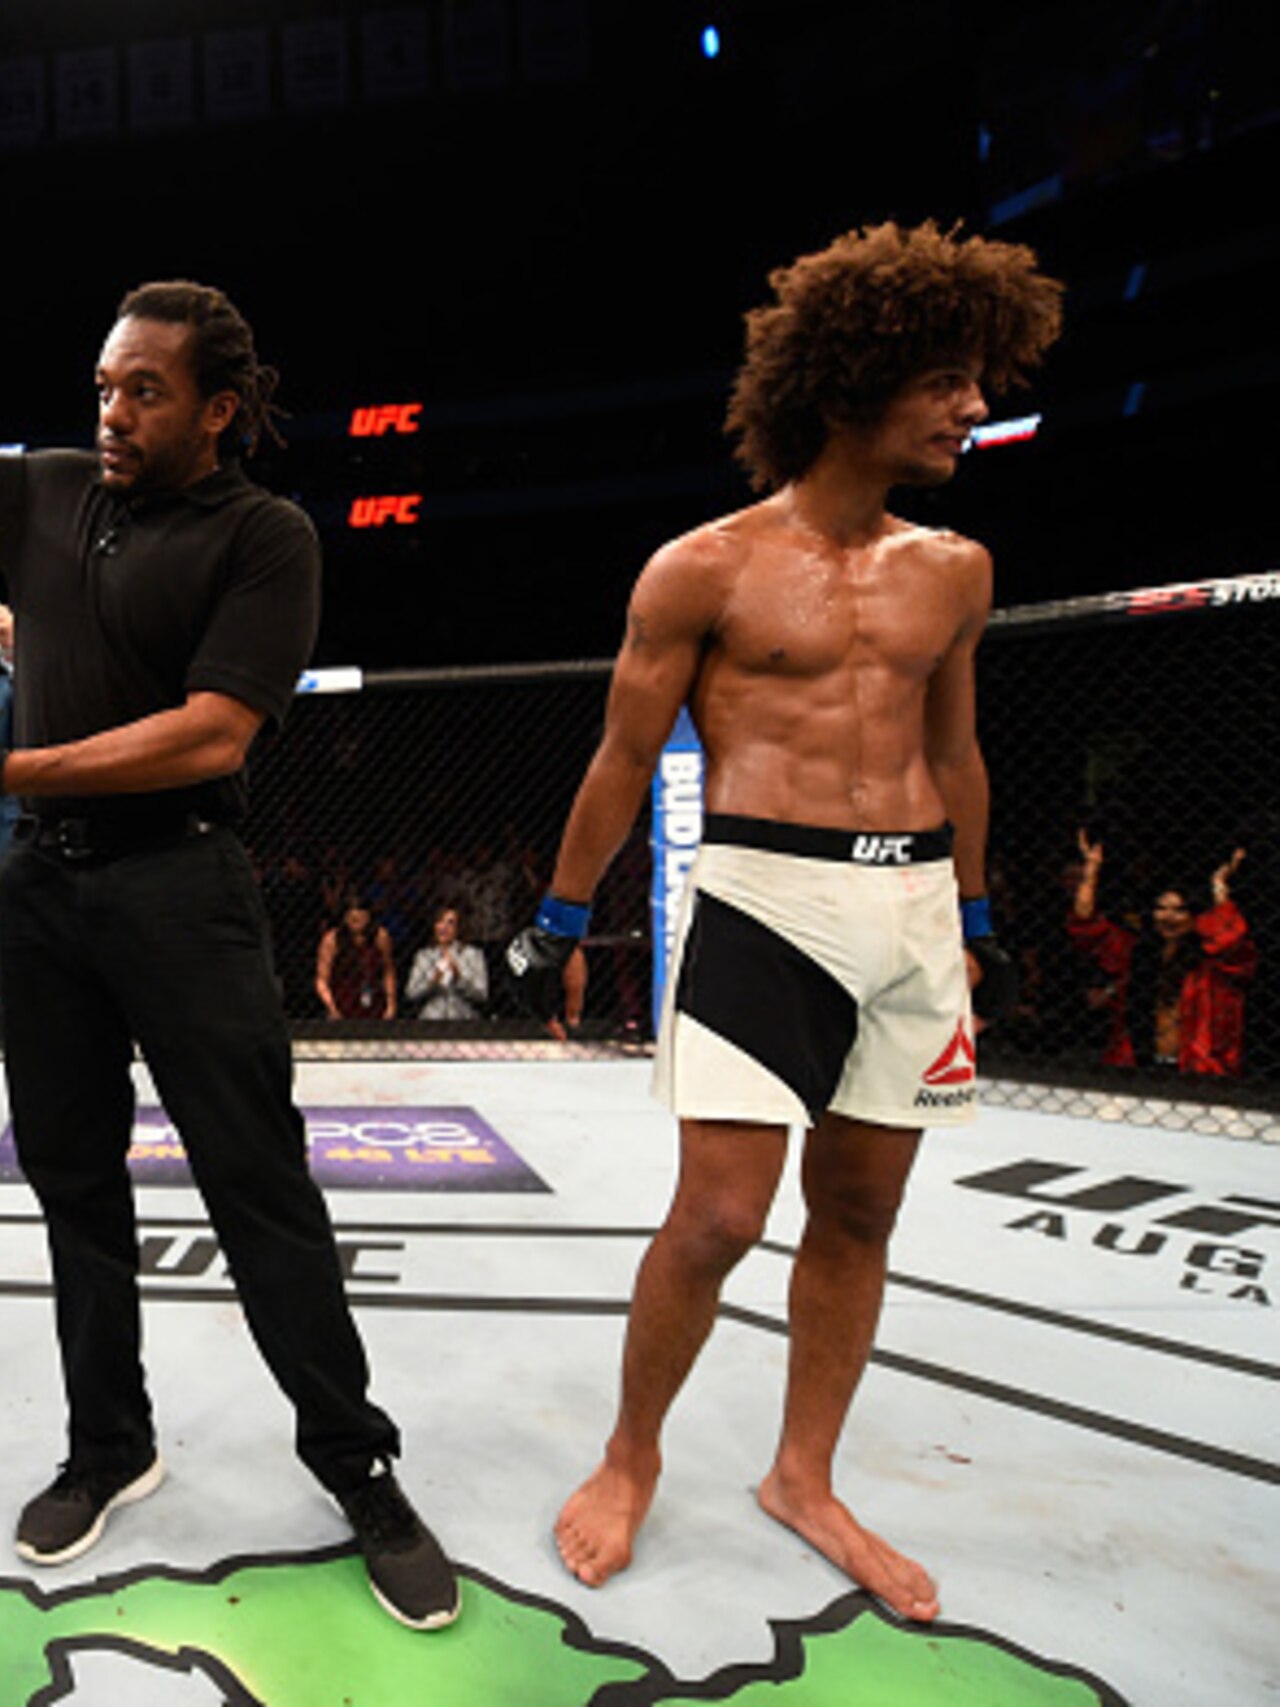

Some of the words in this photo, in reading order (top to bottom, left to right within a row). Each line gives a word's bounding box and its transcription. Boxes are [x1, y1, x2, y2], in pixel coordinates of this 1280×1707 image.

[349, 403, 422, 436] UFC
[348, 492, 422, 527] UFC
[852, 835, 913, 863] UFC
[139, 1235, 405, 1283] UC
[1004, 1210, 1266, 1279] AUG
